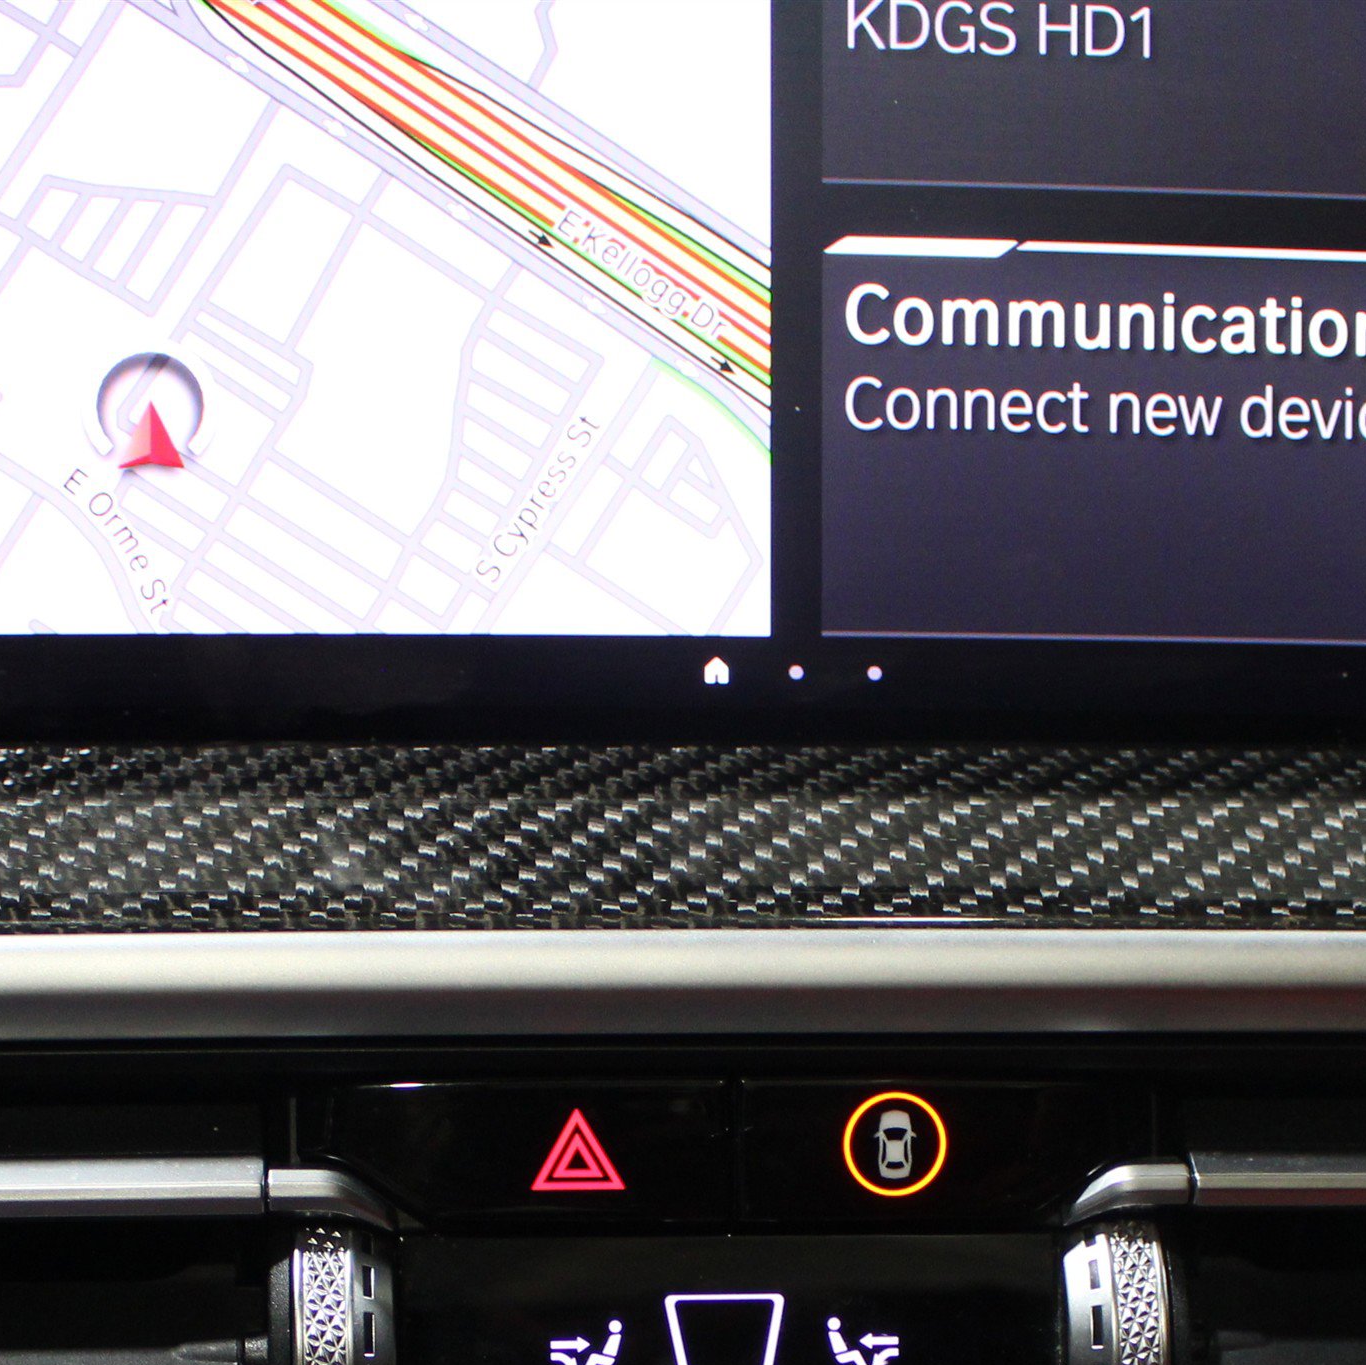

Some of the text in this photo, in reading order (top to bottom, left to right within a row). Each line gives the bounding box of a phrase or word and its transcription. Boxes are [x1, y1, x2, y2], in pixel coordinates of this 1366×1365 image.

[846, 0, 1153, 59] KDGS HD1
[558, 210, 728, 336] E Kellogg Dr
[844, 375, 1089, 434] Connect
[1109, 391, 1223, 436] new
[63, 469, 170, 616] E Orme St
[475, 415, 601, 585] S Cypress St
